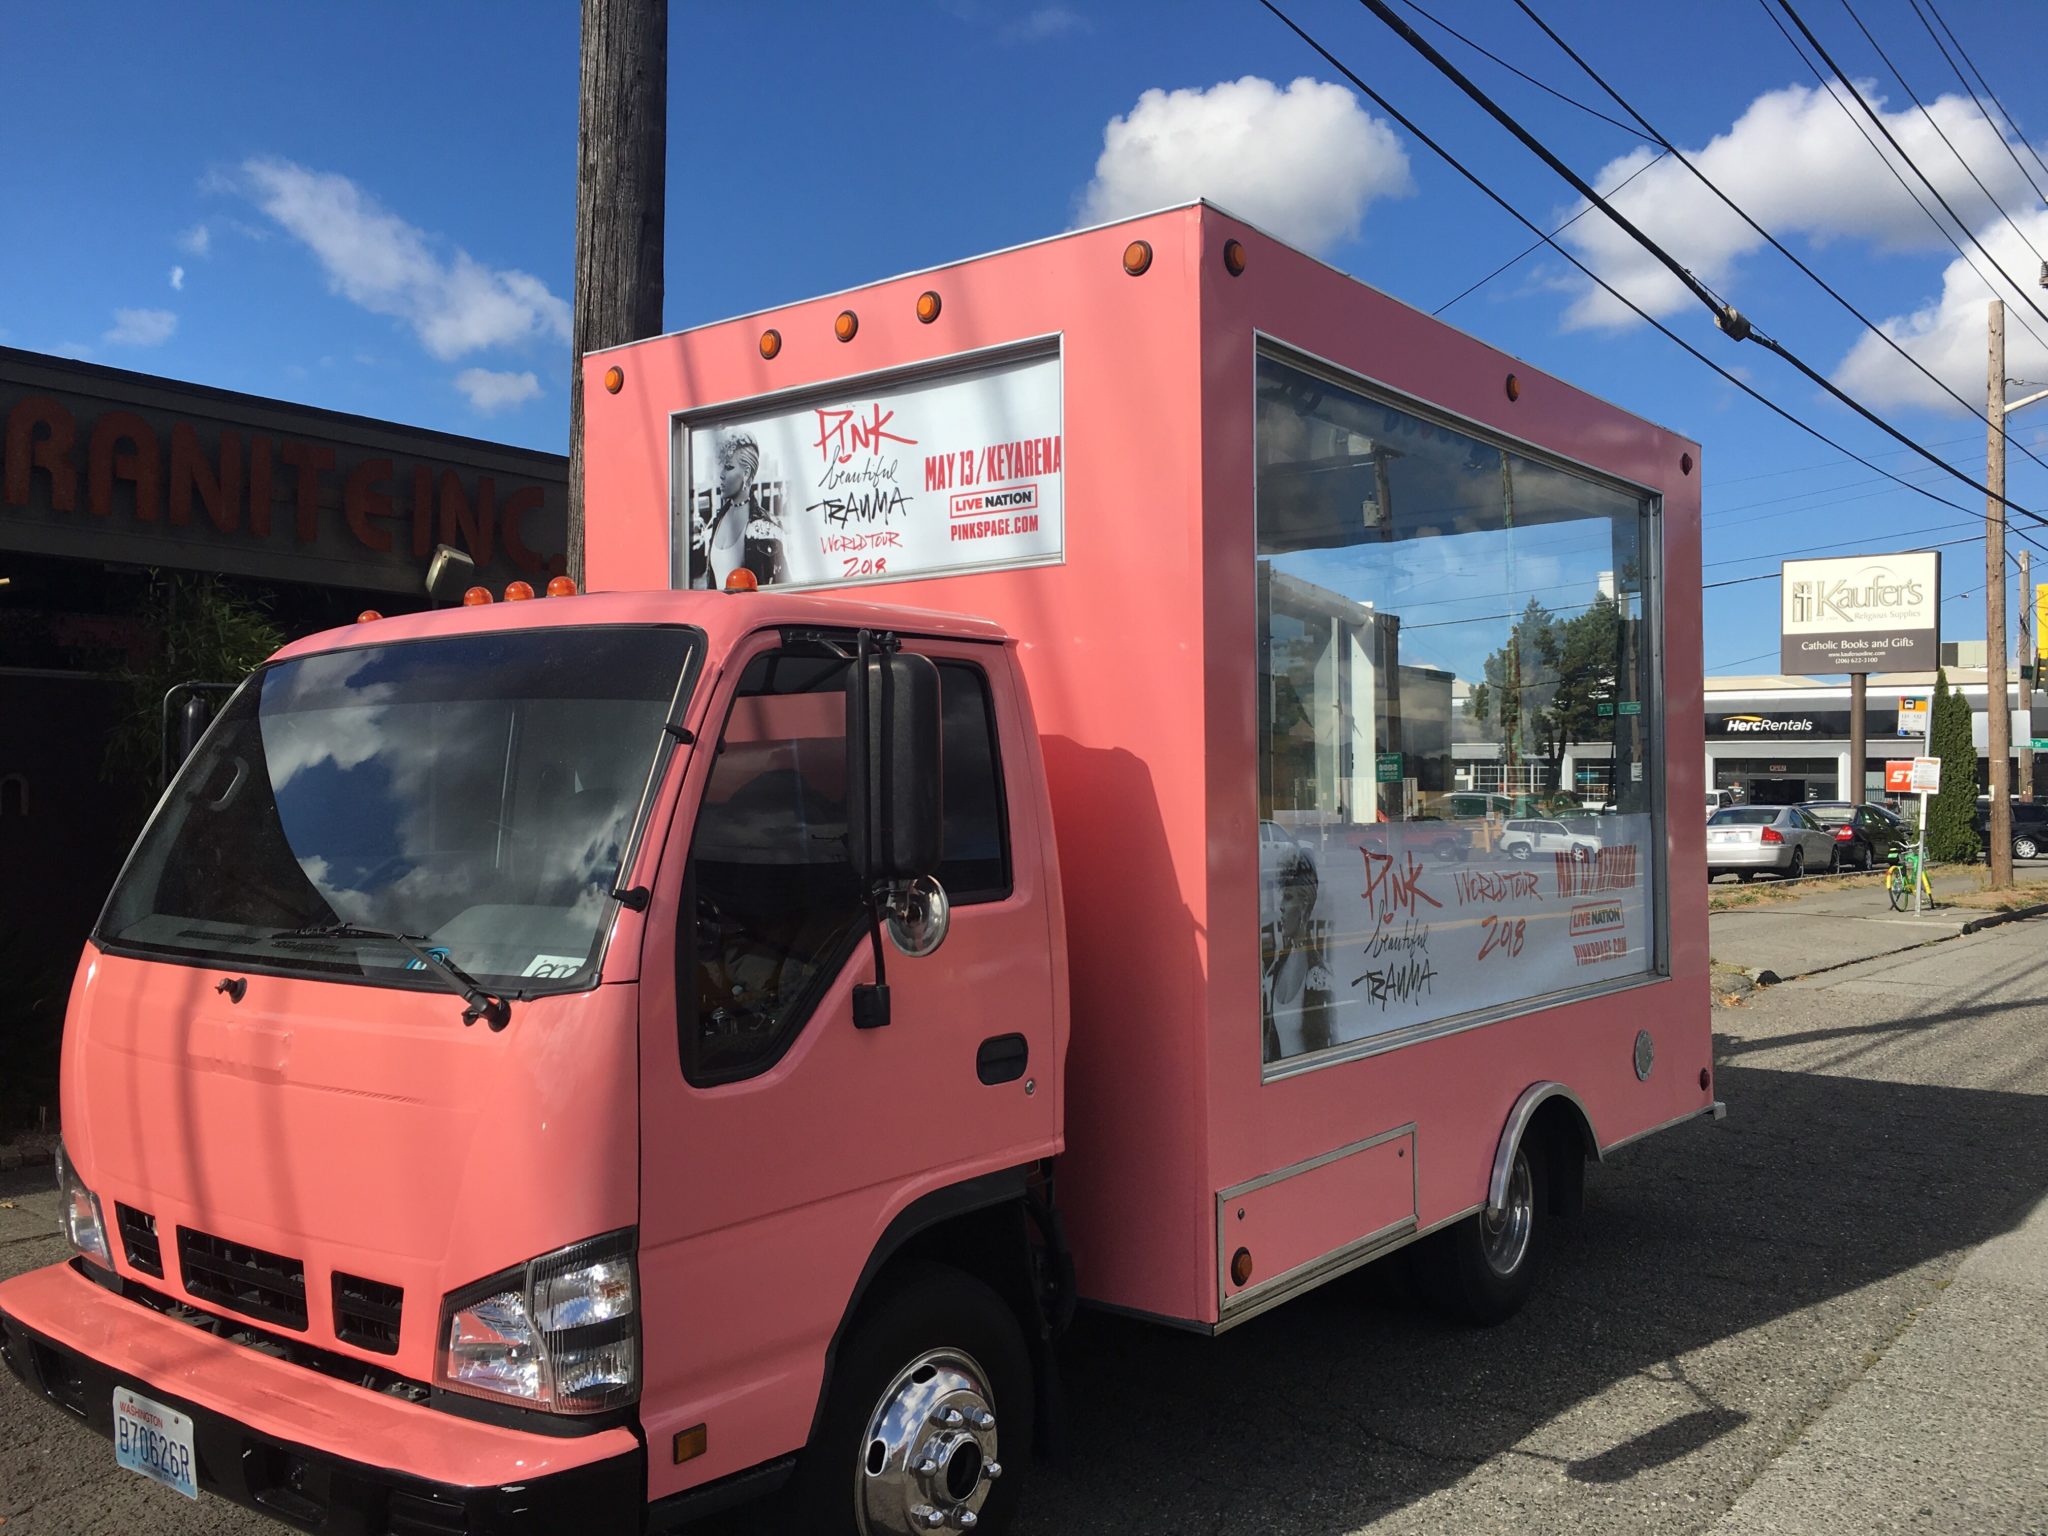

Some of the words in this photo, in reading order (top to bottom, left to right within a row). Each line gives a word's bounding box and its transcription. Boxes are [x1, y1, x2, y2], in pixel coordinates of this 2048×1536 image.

[818, 445, 898, 490] beautiful
[925, 452, 956, 493] MAY
[806, 487, 914, 530] TRAUMA
[955, 498, 983, 512] LIVE
[985, 491, 1032, 508] NATION
[951, 515, 1039, 541] PINKSPAGE.COM
[843, 556, 887, 578] 2018
[1816, 574, 1924, 622] Kaufer's
[1854, 611, 1887, 621] Religious
[1890, 609, 1921, 620] Supplies
[1801, 640, 1838, 651] Catholic
[1841, 639, 1869, 649] Books
[1871, 638, 1889, 648] and
[1891, 637, 1914, 647] Gifts
[1364, 899, 1429, 958] beautiful
[1478, 915, 1526, 960] 2018
[1573, 912, 1590, 928] LIVE
[1591, 907, 1621, 925] NATION
[1352, 958, 1438, 1012] TRAUMA
[119, 1401, 163, 1428] WASHINGTON
[119, 1415, 190, 1485] B70626R
